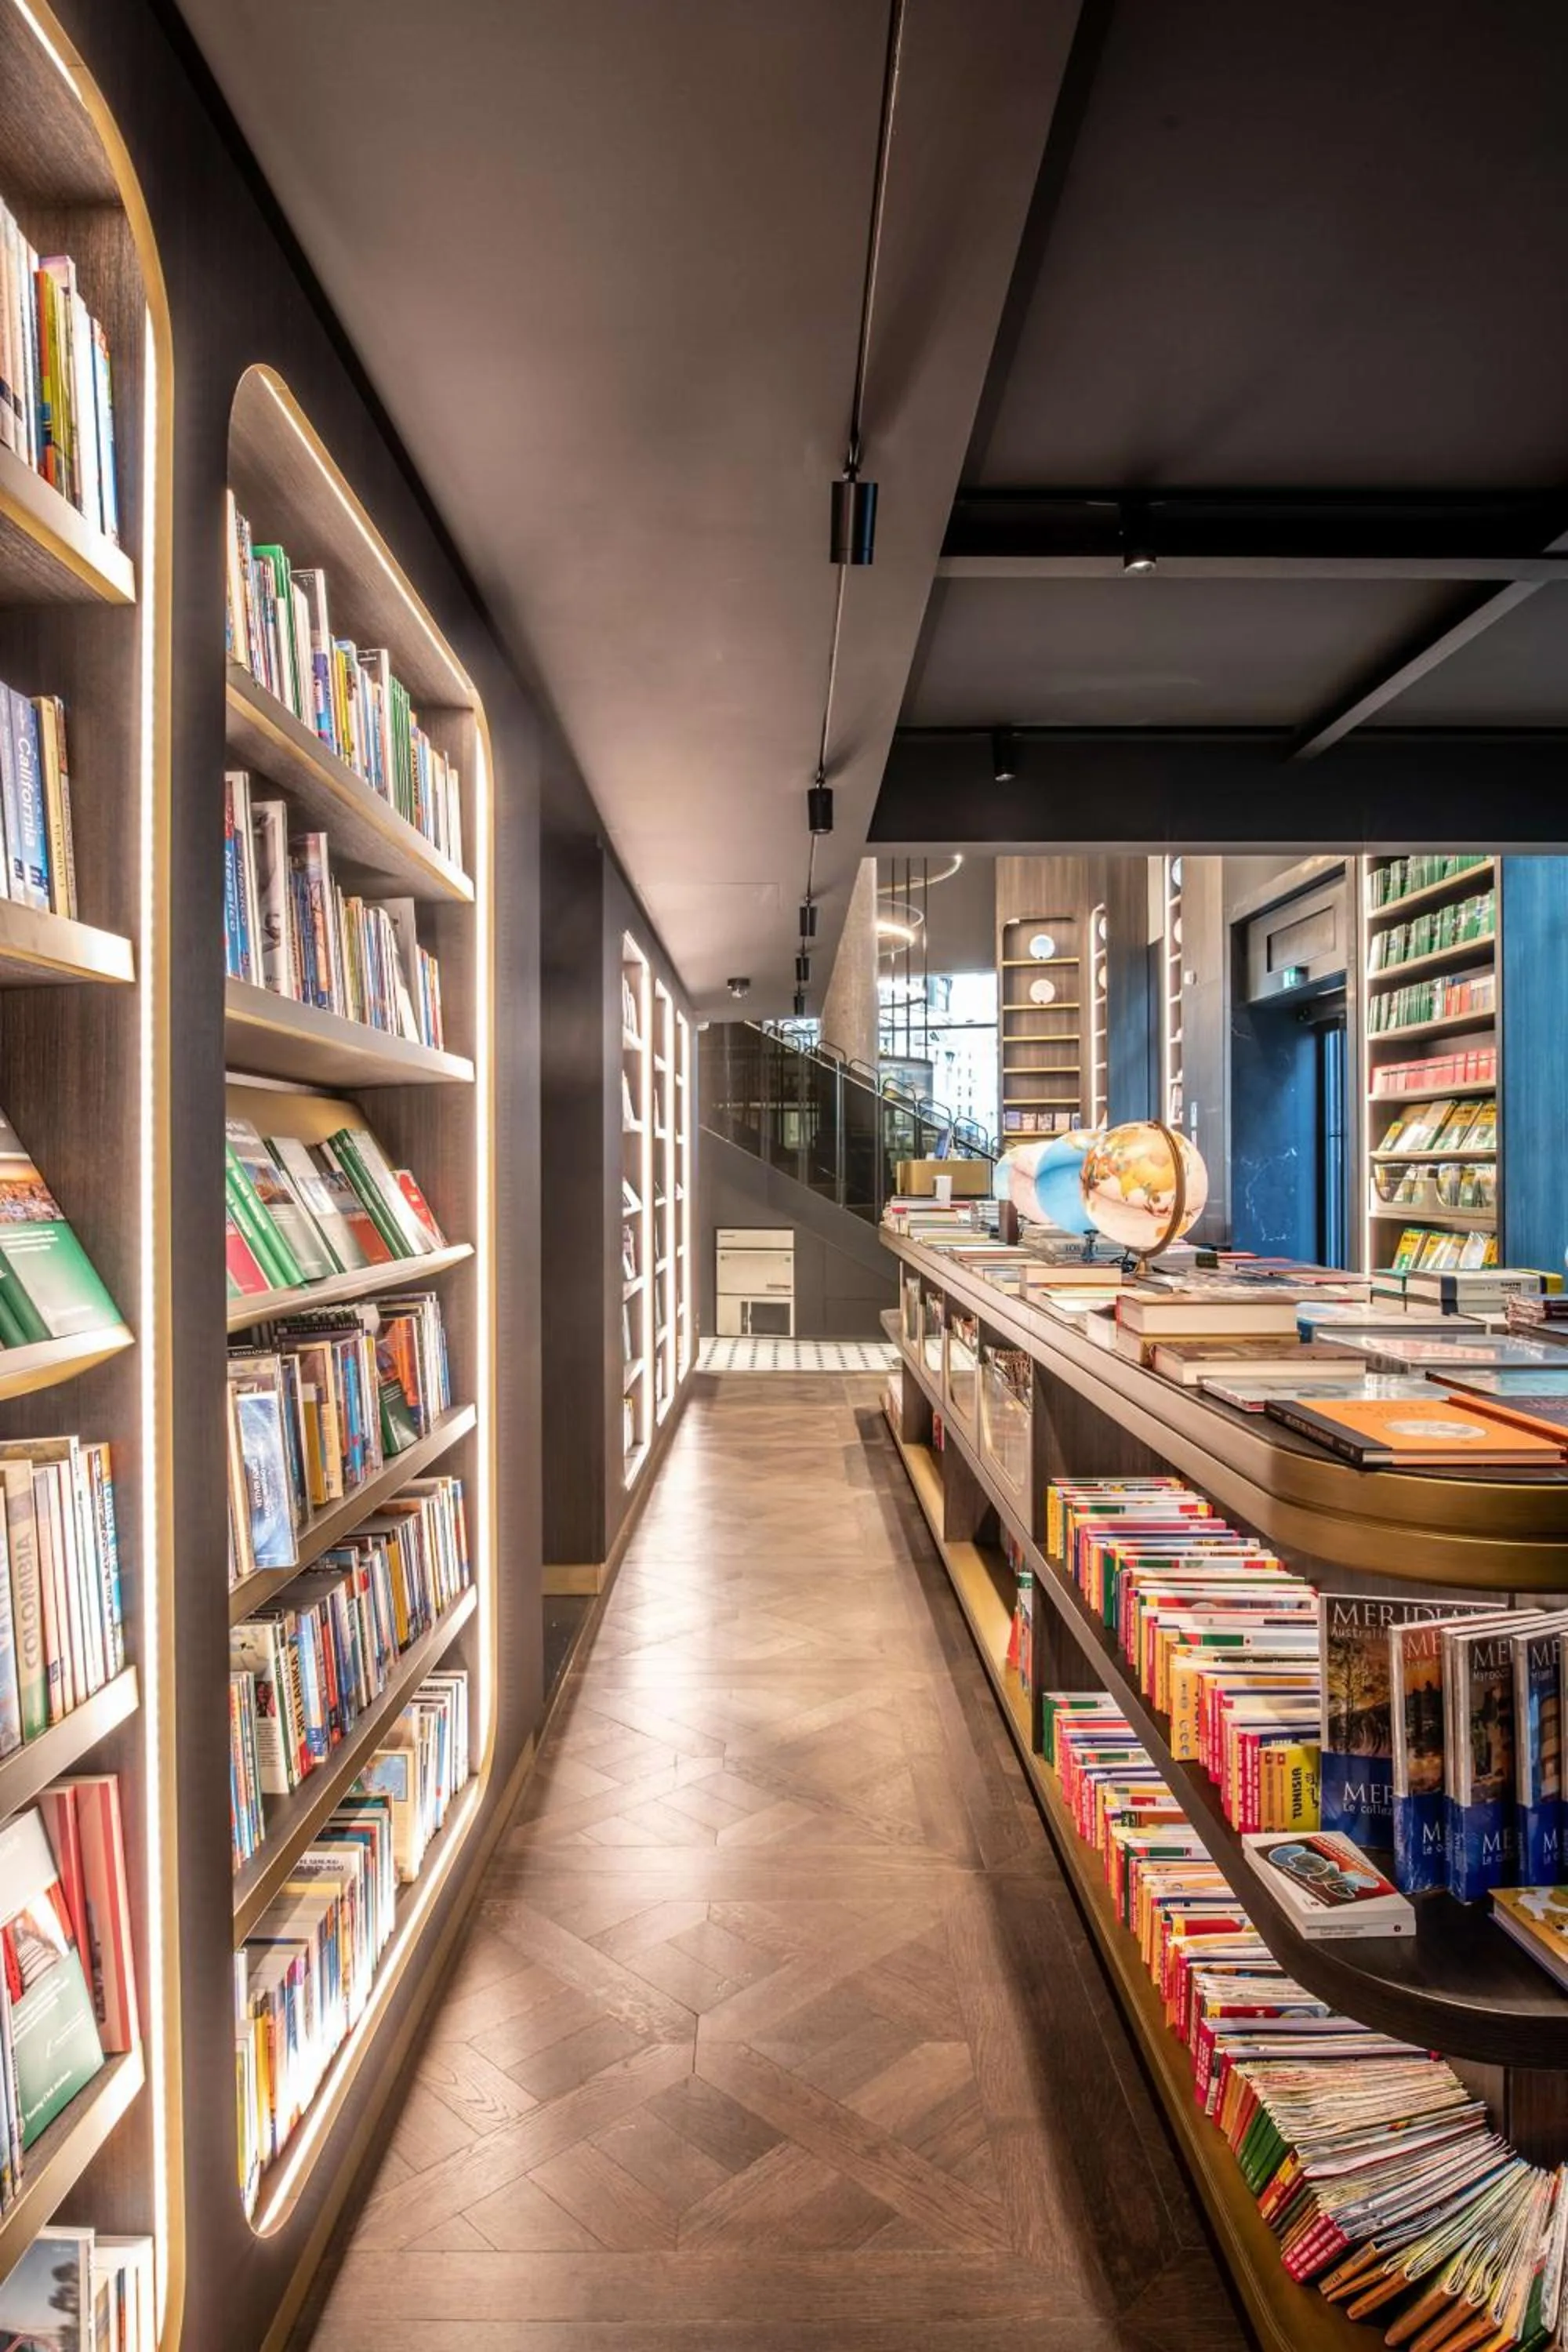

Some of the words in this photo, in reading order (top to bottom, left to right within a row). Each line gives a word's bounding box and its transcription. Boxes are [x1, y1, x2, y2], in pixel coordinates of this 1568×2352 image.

[18, 738, 36, 847] California
[225, 850, 236, 932] Messico
[16, 1532, 38, 1670] COLOMBIA
[1333, 1602, 1480, 1627] MERIDI
[290, 1653, 303, 1710] LANKA
[1291, 1767, 1302, 1820] TUNISIA
